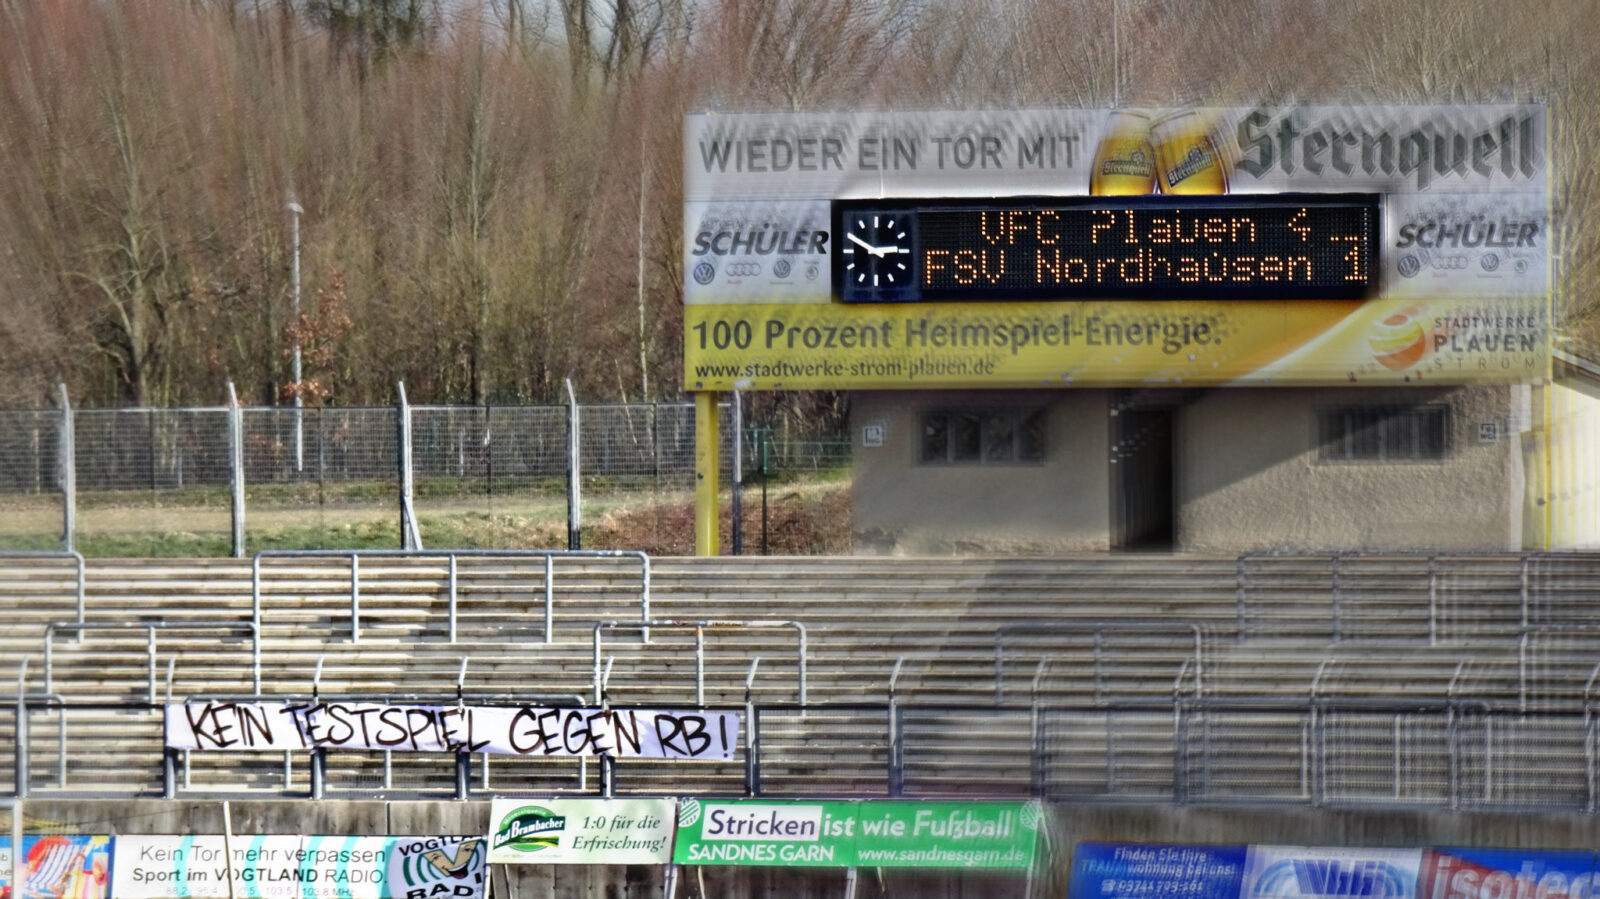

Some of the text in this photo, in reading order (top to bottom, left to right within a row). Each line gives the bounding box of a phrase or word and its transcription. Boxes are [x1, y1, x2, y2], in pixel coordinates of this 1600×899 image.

[699, 134, 1080, 174] WIEDER EIN TOR MIT
[1236, 108, 1538, 191] Sternquell
[981, 207, 1311, 245] VFC Plauen 4
[1395, 214, 1540, 248] SCHÜLER
[691, 222, 829, 256] SCHÜLER
[926, 246, 1368, 285] FSV Nordhausen 1
[1434, 315, 1537, 329] STADTWERKE
[692, 313, 1222, 355] 100 Prozent Heimspiel-Energie.
[1434, 334, 1536, 353] PLAUEN
[695, 358, 995, 380] www.stadtwerke-strom-plauen.de
[1434, 358, 1536, 370] STROM
[185, 702, 274, 749] KEIN
[279, 703, 491, 753] TESTSPIEL
[509, 707, 642, 756] GEGEN
[582, 814, 661, 833] 1:0 für die
[707, 808, 1012, 840] Stricken ist wie Fußball
[572, 834, 668, 853] Erfrischung!
[687, 843, 834, 862] SANDNES GARN
[1114, 847, 1156, 861] Finden
[140, 844, 184, 861] Kein
[190, 844, 222, 861] Tor
[284, 848, 386, 866] verpassen
[857, 844, 1025, 867] www.sandnesgarn.de
[132, 867, 182, 885] Sport
[186, 867, 208, 881] im
